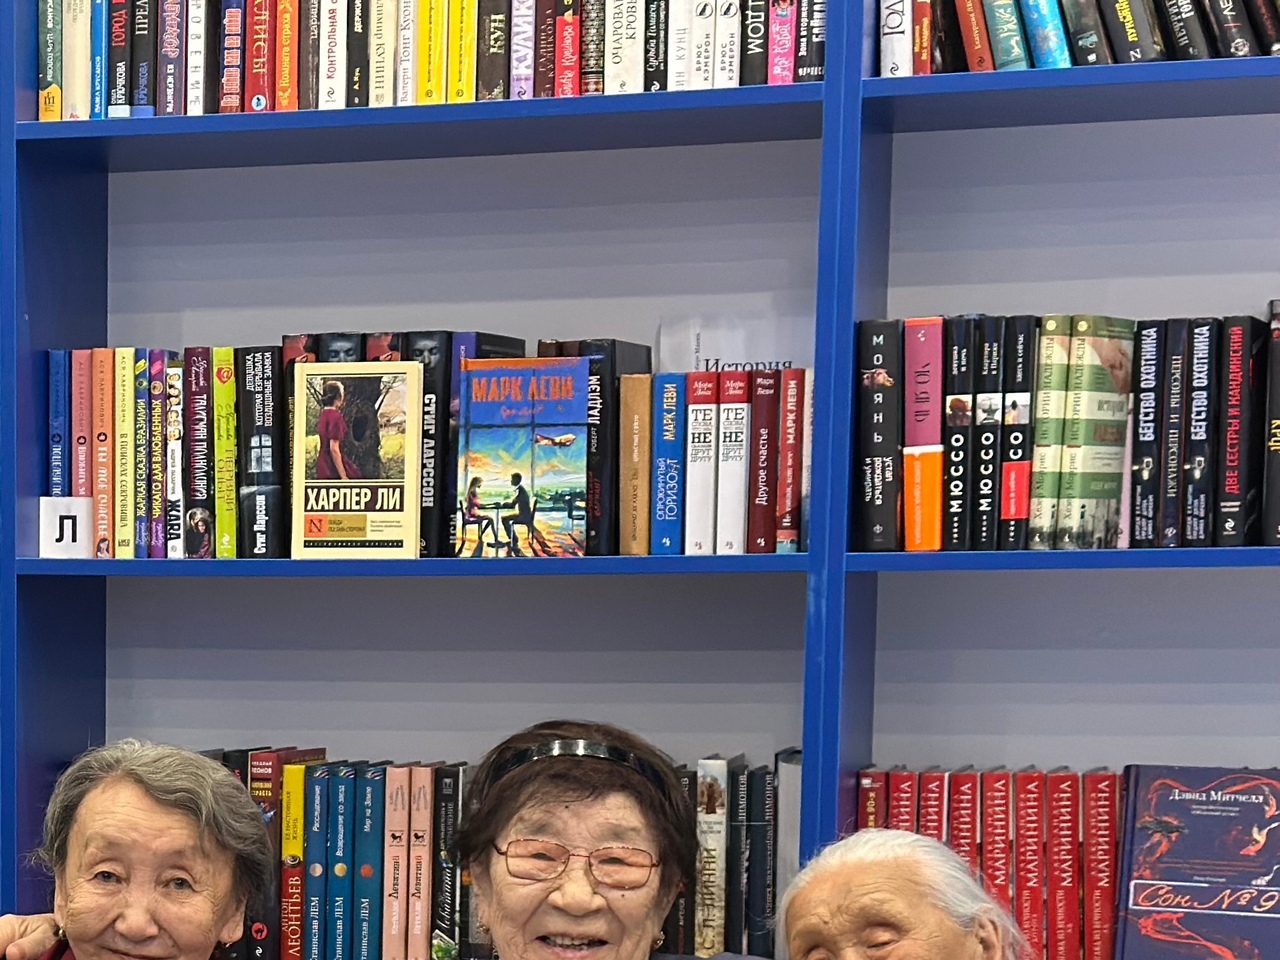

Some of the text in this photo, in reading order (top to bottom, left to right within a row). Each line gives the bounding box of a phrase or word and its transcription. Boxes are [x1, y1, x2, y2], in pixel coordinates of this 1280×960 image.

[111, 8, 129, 46] ГОРОД
[325, 7, 339, 80] КОНТРОЛЬНАЯ
[489, 12, 507, 54] КУН
[702, 31, 711, 83] КЭМЕРОН
[727, 31, 737, 82] КЭМЕРОН
[253, 351, 264, 426] КОТОРАЯ ВЗРЫВАЛА
[262, 351, 273, 427] ВОЗДУШНЫЕ ЗАМКИ
[471, 374, 576, 403] МАРК ЛЕВИ
[1138, 327, 1158, 441] БЕГСТВО ОХОТНИКА
[1190, 325, 1210, 441] БЕГСТВО ОХОТНИКА
[1228, 326, 1244, 406] КАНДИНСКИЙ
[587, 374, 603, 425] ЛАДЛЭМ
[662, 383, 678, 441] МАРК ЛЕВИ
[691, 408, 713, 422] ТЕ
[723, 407, 745, 421] ТЕ
[786, 379, 799, 445] МАРК ЛЕВИ
[151, 400, 163, 519] ЧИКАГО ДЛЯ ВЛЮБЛЕННЫХ
[422, 393, 437, 508] СТИГ ЛАРССОН
[691, 432, 713, 444] НЕ
[722, 432, 744, 444] НЕ
[1226, 419, 1240, 467] СЕСТРЫ
[136, 451, 147, 479] СКАЗКА
[656, 456, 666, 520] ОПРОКИНУТЫЙ
[755, 428, 769, 505] Другое счастье
[949, 433, 964, 512] МЮССО
[978, 431, 994, 511] МЮССО
[1225, 469, 1239, 495] ДВЕ
[136, 481, 147, 517] ЖАРКАЯ
[167, 497, 182, 541] ЖАРА
[253, 494, 269, 532] Ларссон
[306, 487, 402, 511] ХАРПЕР ЛИ
[55, 514, 78, 543] Л
[1169, 788, 1265, 804] Дэвид Митчелл
[992, 779, 1006, 886] МАРИНИНА
[1026, 780, 1040, 888] МАРИНИНА
[1059, 780, 1073, 888] МАРИНИНА
[1096, 780, 1110, 888] МАРИНИНА
[287, 875, 302, 958] ЛЕОНТЬЕВ
[310, 896, 320, 919] ЛЕМ
[333, 896, 344, 919] ЛЕМ
[359, 897, 370, 920] ЛЕМ
[1138, 884, 1192, 908] Сон
